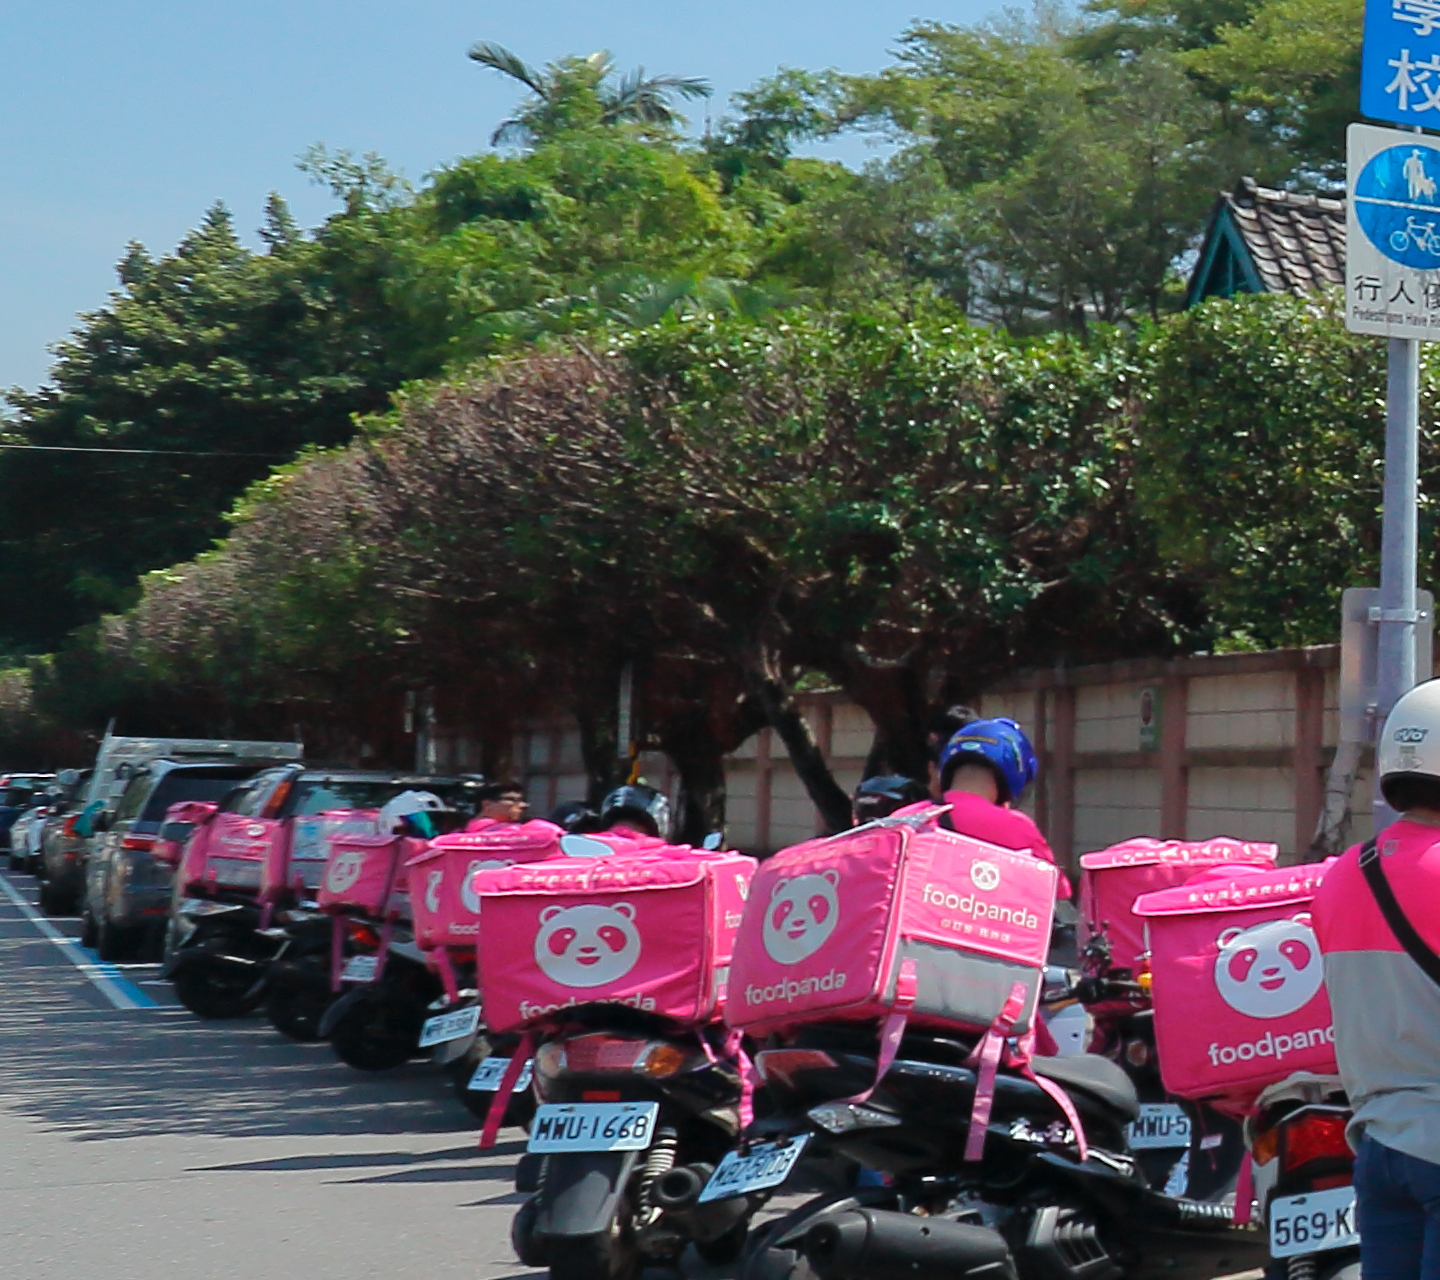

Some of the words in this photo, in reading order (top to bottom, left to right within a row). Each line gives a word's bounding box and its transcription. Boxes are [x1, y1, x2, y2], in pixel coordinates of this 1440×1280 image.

[922, 884, 1039, 930] foodpanda
[744, 969, 847, 1006] foodpanda
[1208, 1024, 1337, 1066] foodpan
[534, 1115, 649, 1141] MWU-1668
[1132, 1115, 1188, 1138] MWU-5
[1275, 1206, 1351, 1247] 569-K
